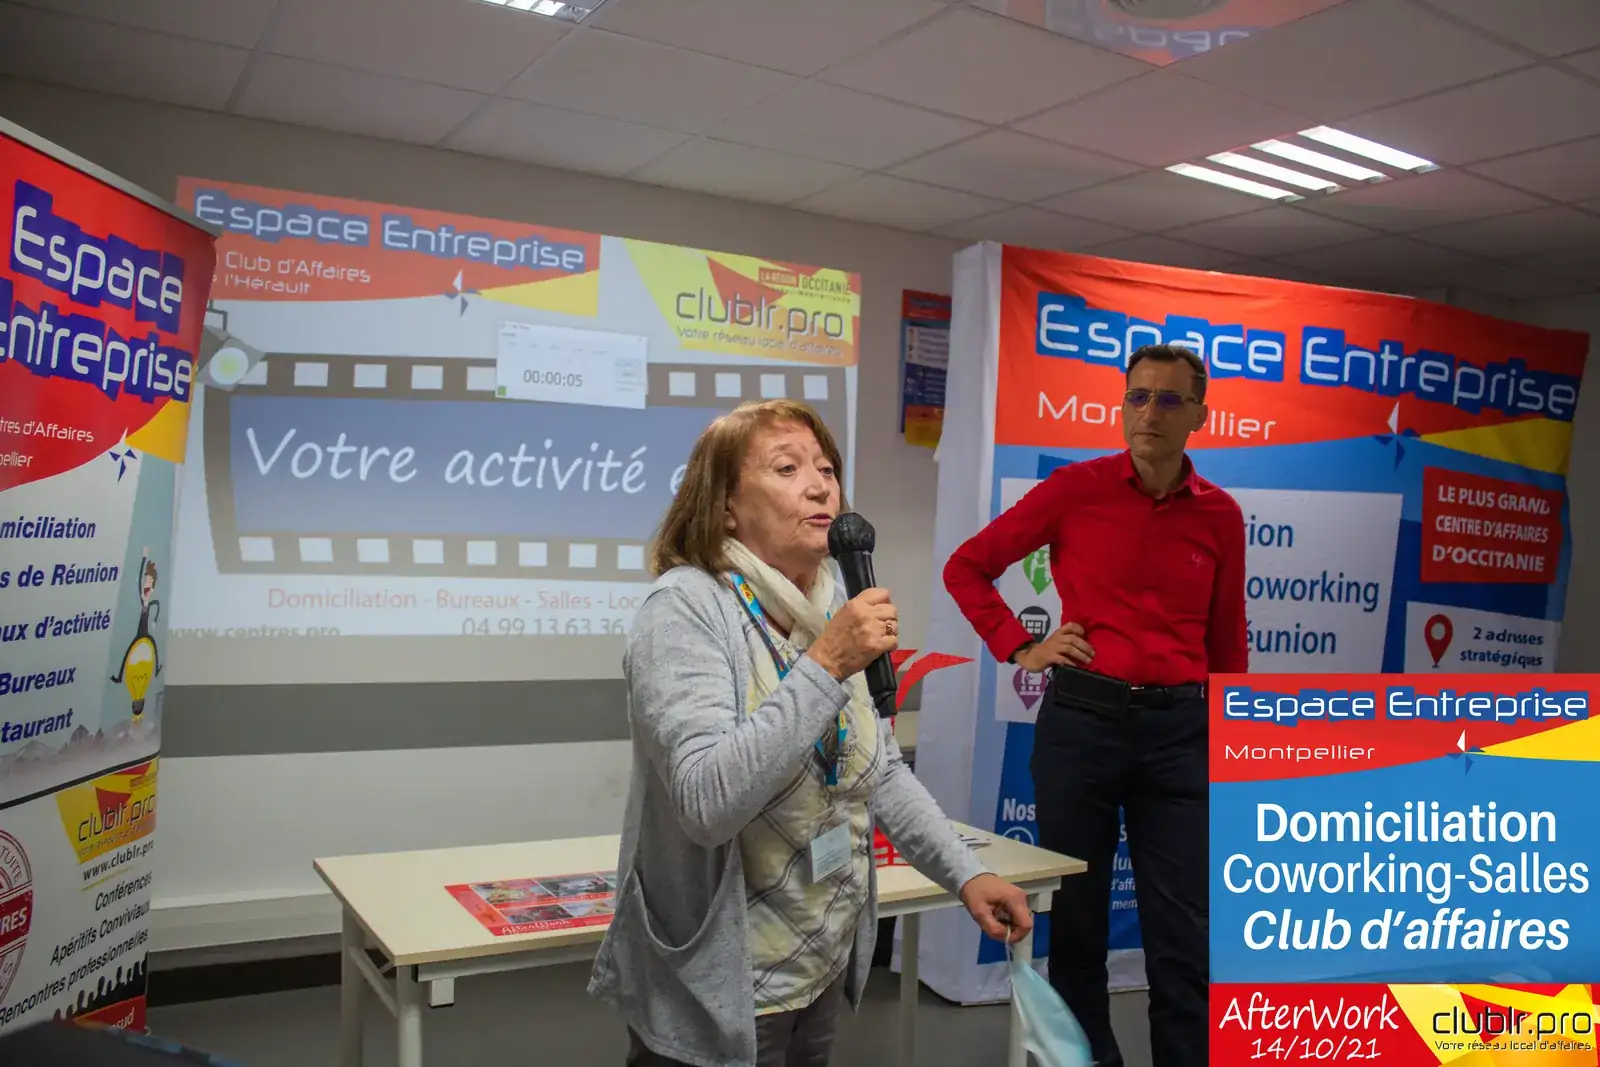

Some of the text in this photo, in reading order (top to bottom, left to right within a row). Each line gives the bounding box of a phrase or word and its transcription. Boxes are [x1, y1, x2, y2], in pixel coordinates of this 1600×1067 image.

[196, 194, 585, 271] Espace Entreprise
[14, 205, 183, 314] Espace
[226, 251, 371, 284] Club d'Affaires
[225, 274, 311, 294] l'Hérault
[676, 287, 845, 341] clublr.pro
[524, 369, 583, 388] 00:00:05
[1305, 336, 1577, 416] Entreprise
[23, 420, 94, 443] d'Affaires
[246, 427, 417, 484] Votre
[444, 438, 649, 495] activité
[1438, 484, 1550, 515] LE PLUS GRAND
[1435, 515, 1549, 544] CENTRE D'AFFAIRES
[1432, 544, 1545, 573] D'OCCITANIE
[18, 565, 44, 588] de
[51, 562, 119, 586] Réunion
[267, 587, 416, 610] Domiciliation
[436, 588, 519, 610] Bureaux
[537, 589, 592, 611] Salles
[1246, 570, 1380, 613] oworking
[35, 609, 111, 639] d'activité
[461, 617, 625, 636] 04 99 13 63 36
[1246, 620, 1337, 654] éunion
[1473, 626, 1482, 640] 2
[1460, 648, 1543, 669] stratégiques
[0, 667, 76, 696] Bureaux
[1003, 797, 1036, 822] Nos
[95, 870, 152, 912] Conférences
[50, 926, 98, 967] Apéritifs
[0, 979, 66, 1027] Rencontres
[67, 928, 149, 991] professionnelles
